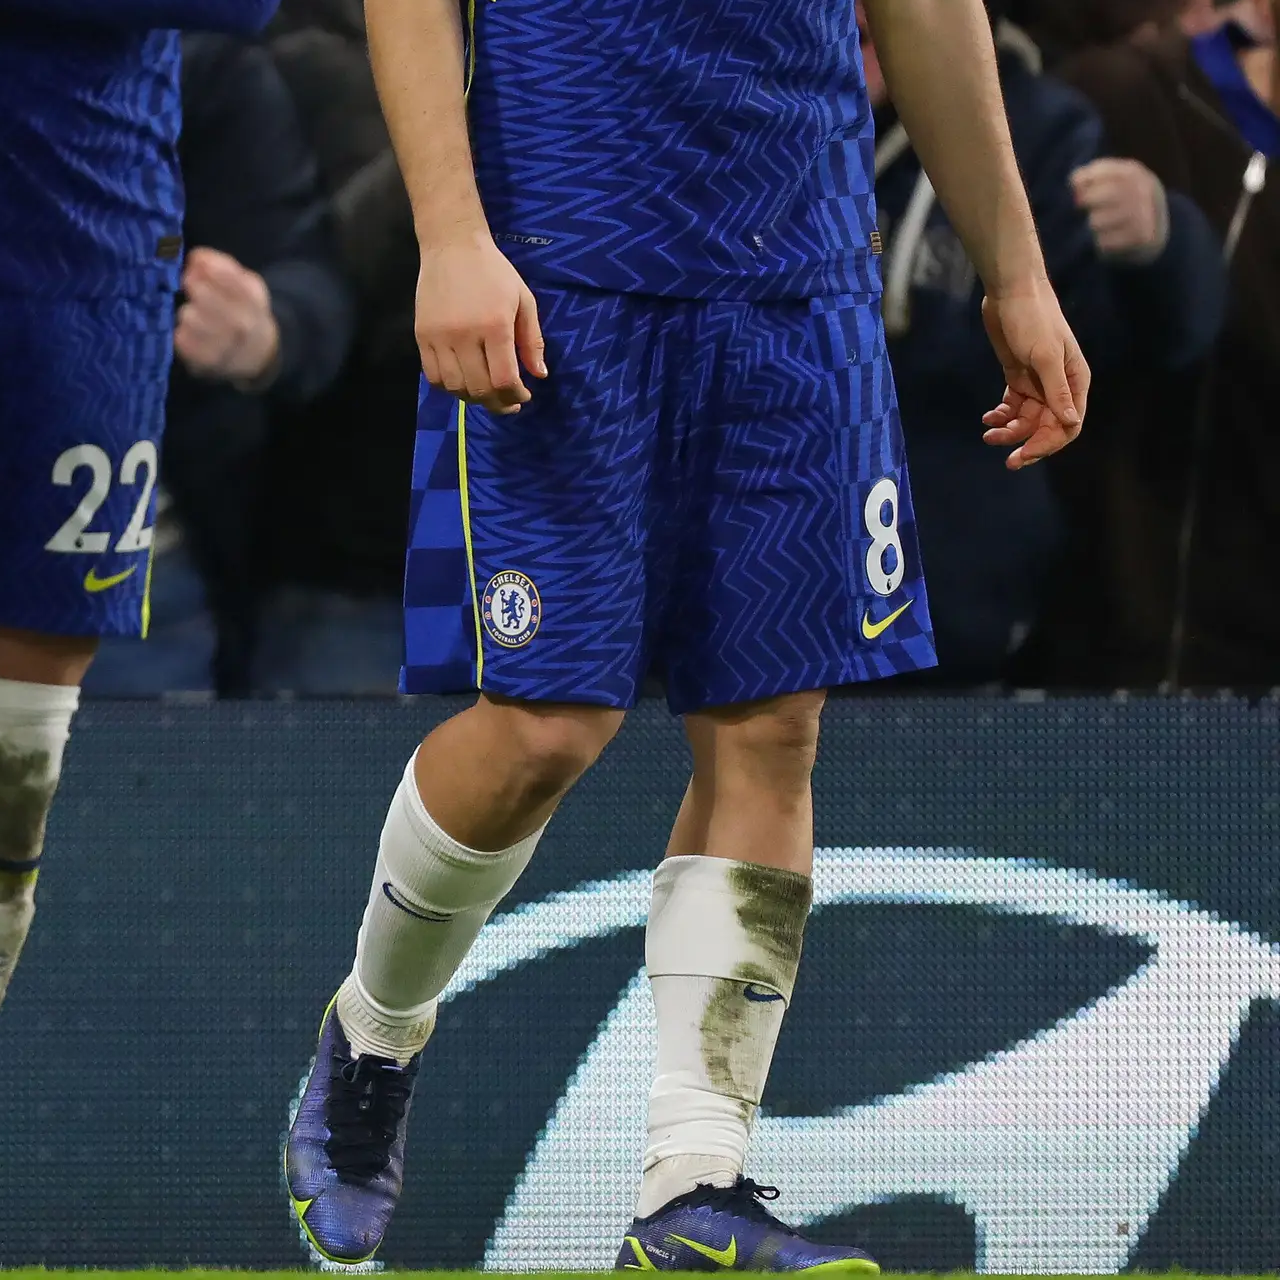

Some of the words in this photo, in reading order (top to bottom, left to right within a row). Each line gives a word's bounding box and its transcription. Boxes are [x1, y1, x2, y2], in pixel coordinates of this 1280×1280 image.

[43, 440, 159, 554] 22
[864, 477, 905, 596] 8
[492, 574, 530, 592] CHELSEA
[491, 628, 517, 644] FOOTBALL
[518, 630, 531, 642] CLUB
